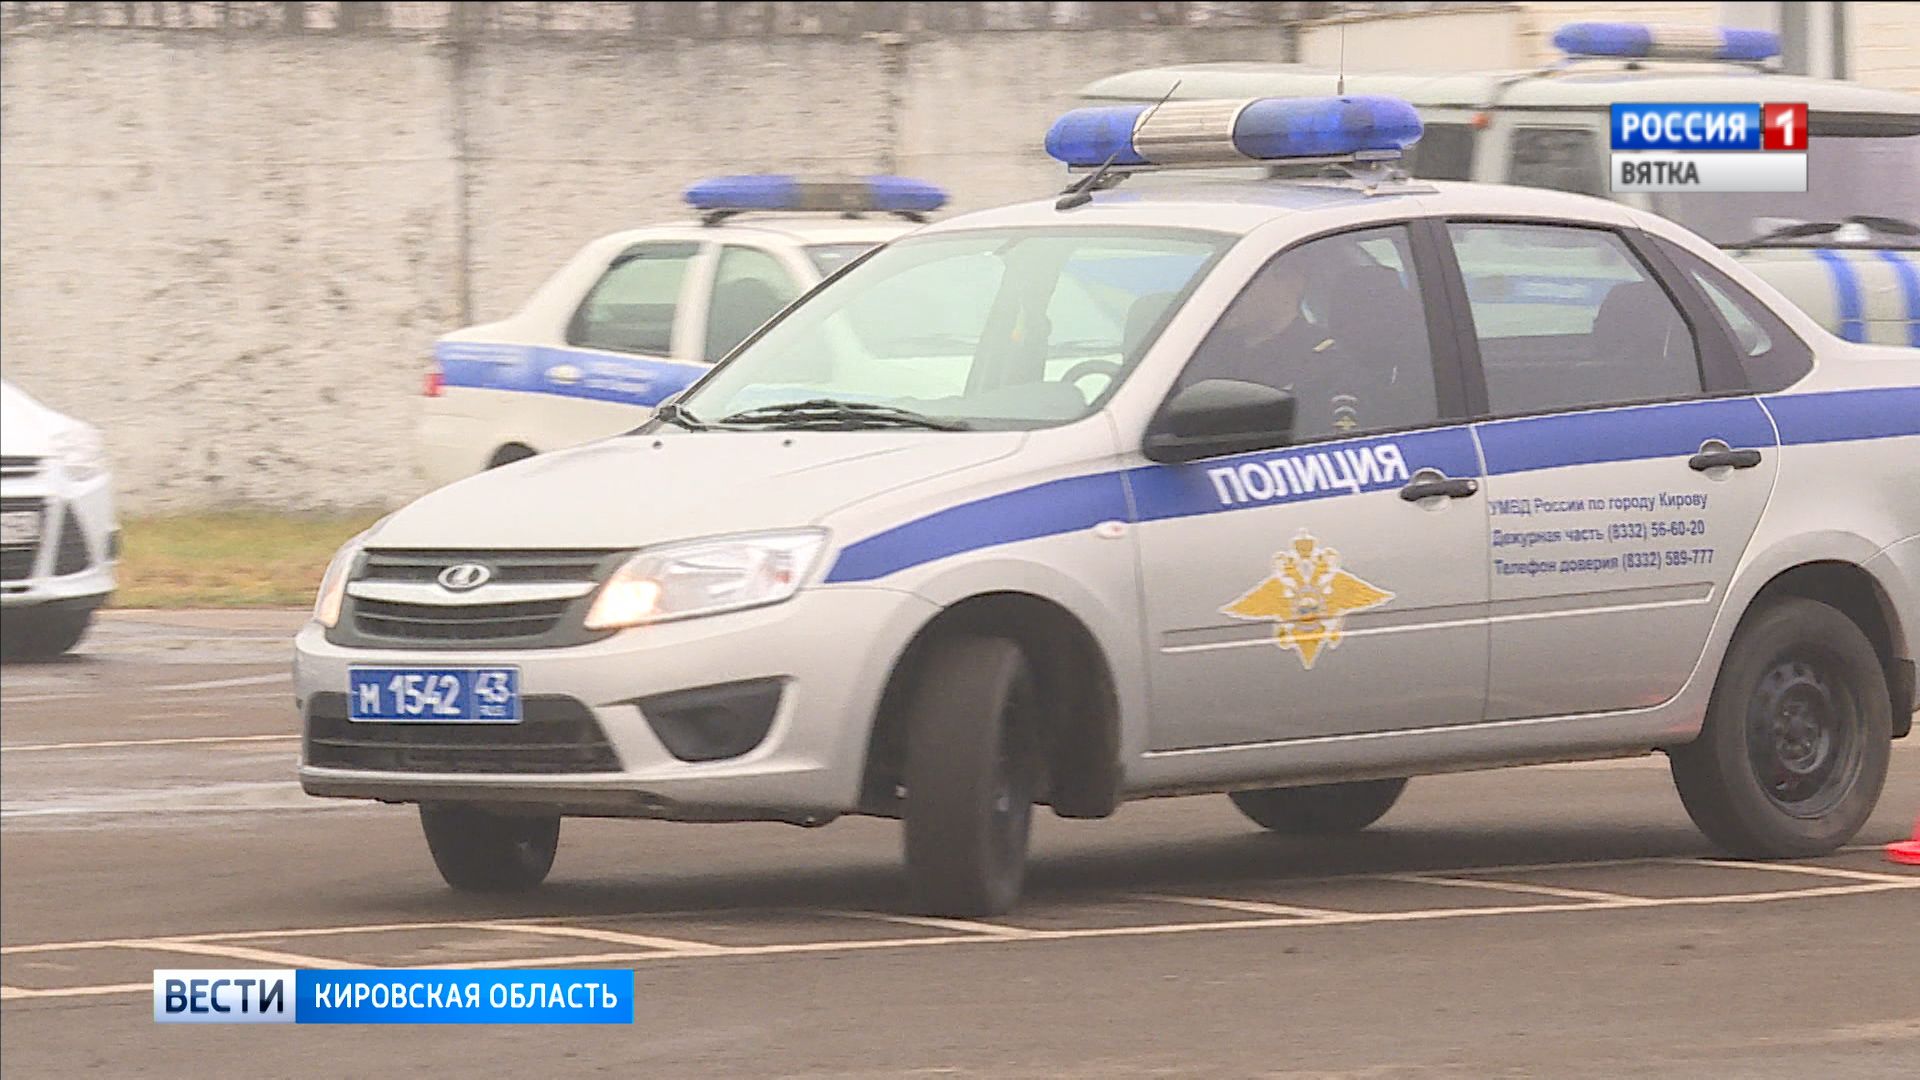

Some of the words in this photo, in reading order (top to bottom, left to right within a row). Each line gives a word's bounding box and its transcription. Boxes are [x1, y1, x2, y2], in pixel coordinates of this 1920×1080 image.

[1207, 443, 1410, 504] ПОЛИЦИЯ
[1534, 498, 1585, 513] России
[1588, 499, 1605, 510] по
[1609, 497, 1656, 512] городу
[1659, 492, 1708, 510] Кирову
[1493, 529, 1562, 547] Дежурная
[1566, 528, 1605, 542] часть
[1607, 523, 1648, 542] (8332)
[1651, 519, 1705, 538] 56-60-20
[1494, 559, 1557, 576] Телефон
[1559, 557, 1619, 573] доверия
[1621, 552, 1663, 571] (8332)
[1665, 549, 1714, 566] 589-777
[388, 674, 461, 715] 1542
[475, 672, 510, 703] 43
